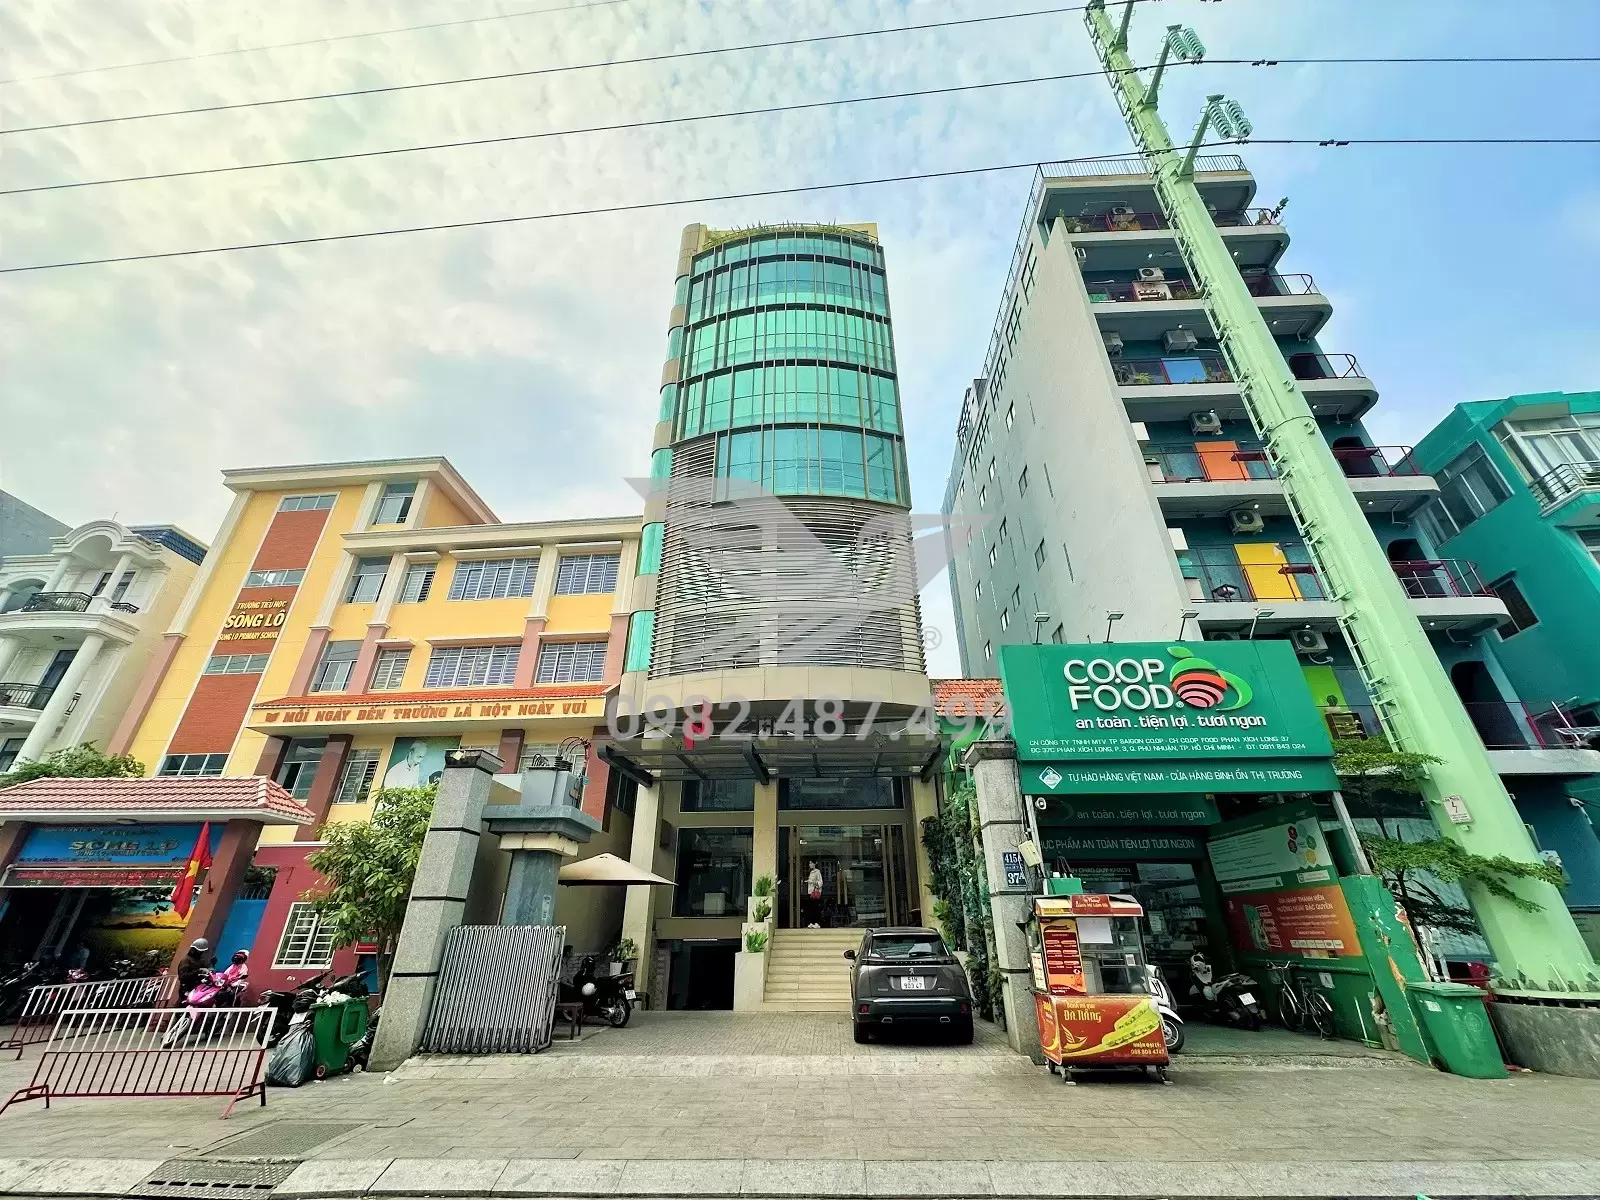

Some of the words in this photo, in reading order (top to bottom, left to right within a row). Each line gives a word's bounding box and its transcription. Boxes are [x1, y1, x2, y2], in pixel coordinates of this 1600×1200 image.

[224, 611, 263, 628] SÔNG
[264, 609, 286, 627] LÔ
[1064, 658, 1165, 684] CO.OP
[1068, 684, 1174, 711] FOOD
[315, 708, 351, 721] NGÀY
[357, 706, 387, 720] ĐẾN
[393, 705, 448, 720] TRƯỜNG
[454, 703, 472, 717] LÀ
[480, 703, 512, 718] MỘT
[518, 701, 554, 715] NGÀY
[1076, 719, 1094, 728] an
[1096, 715, 1131, 728] toàn
[1138, 715, 1169, 730] tiện
[1169, 715, 1188, 730] lợi
[1197, 715, 1228, 727] tươi
[1229, 715, 1267, 729] ngon
[1068, 773, 1079, 783] TỰ
[1081, 770, 1098, 781] HÀO
[1099, 770, 1124, 781] HÀNG
[1125, 770, 1142, 783] VIỆT
[1143, 772, 1164, 781] NAM
[1188, 769, 1213, 780] HÀNG
[1214, 769, 1234, 780] BÌNH
[1250, 771, 1266, 781] THỊ
[1266, 768, 1303, 779] TRƯỜNG
[1077, 811, 1089, 819] an
[1092, 809, 1115, 819] toàn
[1180, 811, 1206, 820] ngon
[1083, 840, 1095, 849] AN
